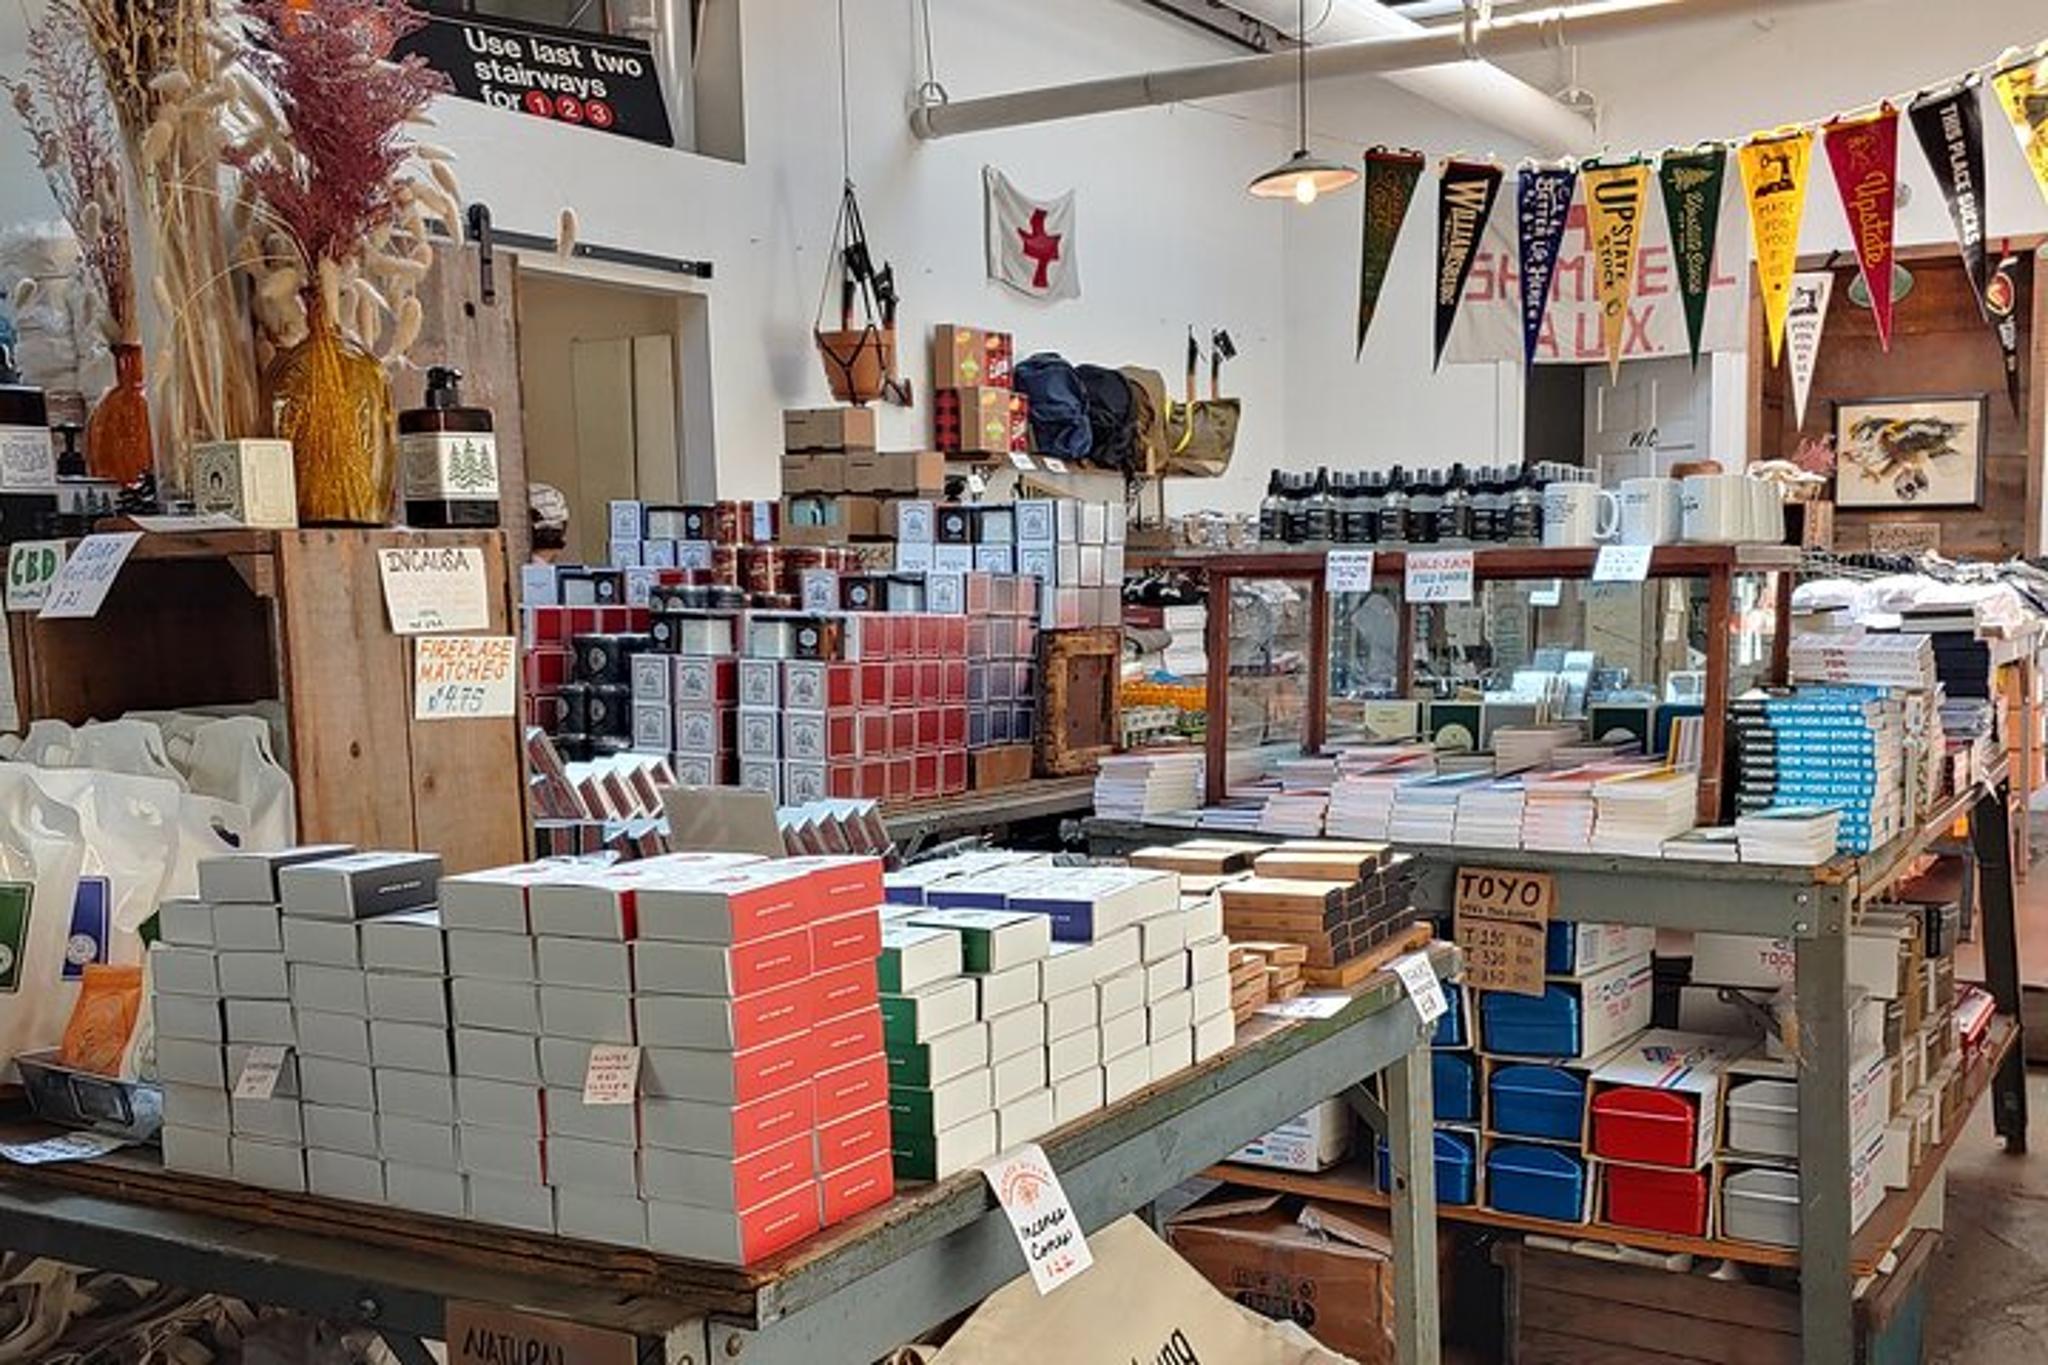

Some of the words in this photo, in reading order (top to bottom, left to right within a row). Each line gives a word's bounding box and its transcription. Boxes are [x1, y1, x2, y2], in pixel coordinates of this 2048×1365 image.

[463, 27, 521, 57] Use
[531, 39, 583, 69] last
[591, 49, 643, 77] two
[475, 59, 607, 98] stairways
[482, 84, 521, 111] for
[1595, 177, 1639, 280] UPSTATE
[1849, 170, 1890, 269] Upstate
[1764, 233, 1790, 246] YOU
[11, 548, 56, 586] CBD
[420, 639, 512, 660] FIREPLACE
[419, 658, 510, 683] MATCHES
[1461, 872, 1540, 907] TOYO
